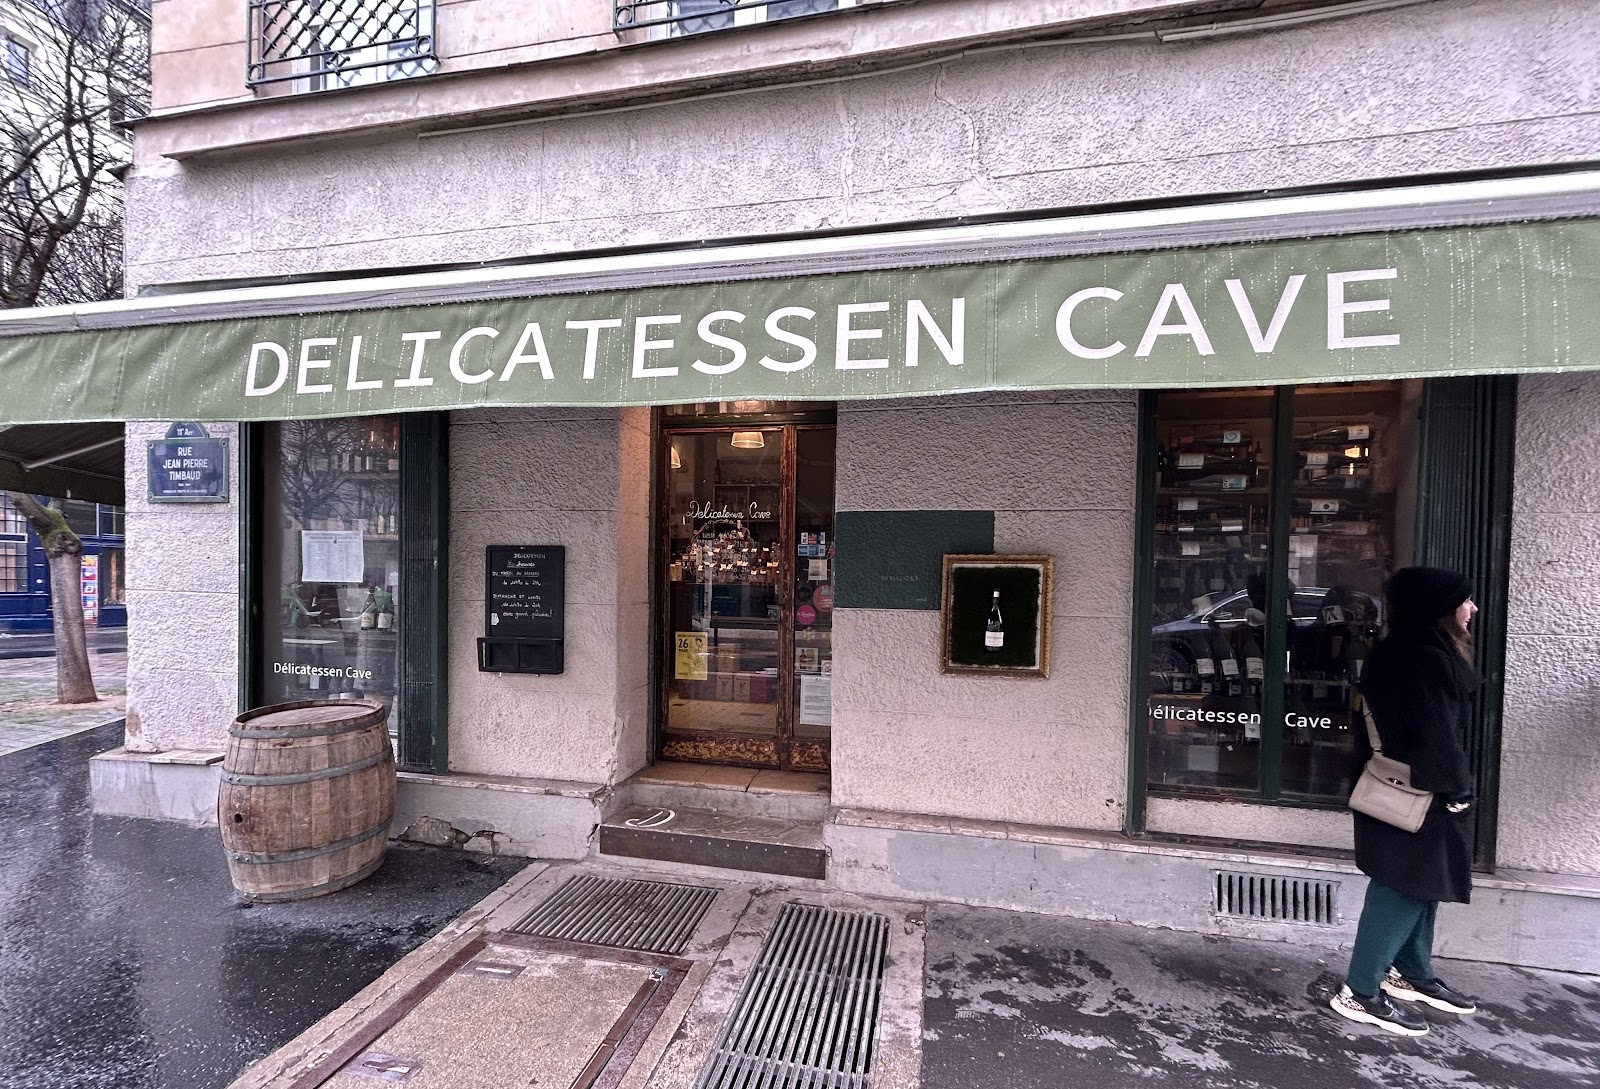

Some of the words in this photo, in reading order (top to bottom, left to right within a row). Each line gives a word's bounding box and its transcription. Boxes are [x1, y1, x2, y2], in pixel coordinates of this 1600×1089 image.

[244, 297, 966, 397] DELICATESSEN
[1055, 267, 1400, 360] CAVE
[178, 447, 193, 456] RUE
[163, 459, 181, 469] JEAN
[183, 459, 209, 468] PIERRE
[169, 471, 201, 480] TIMBAUD
[748, 501, 771, 519] Cave
[679, 639, 689, 648] 26
[273, 662, 343, 677] Délicatessen
[345, 666, 372, 679] Cave
[1148, 705, 1261, 725] élicatessen
[1284, 712, 1331, 729] Cave
